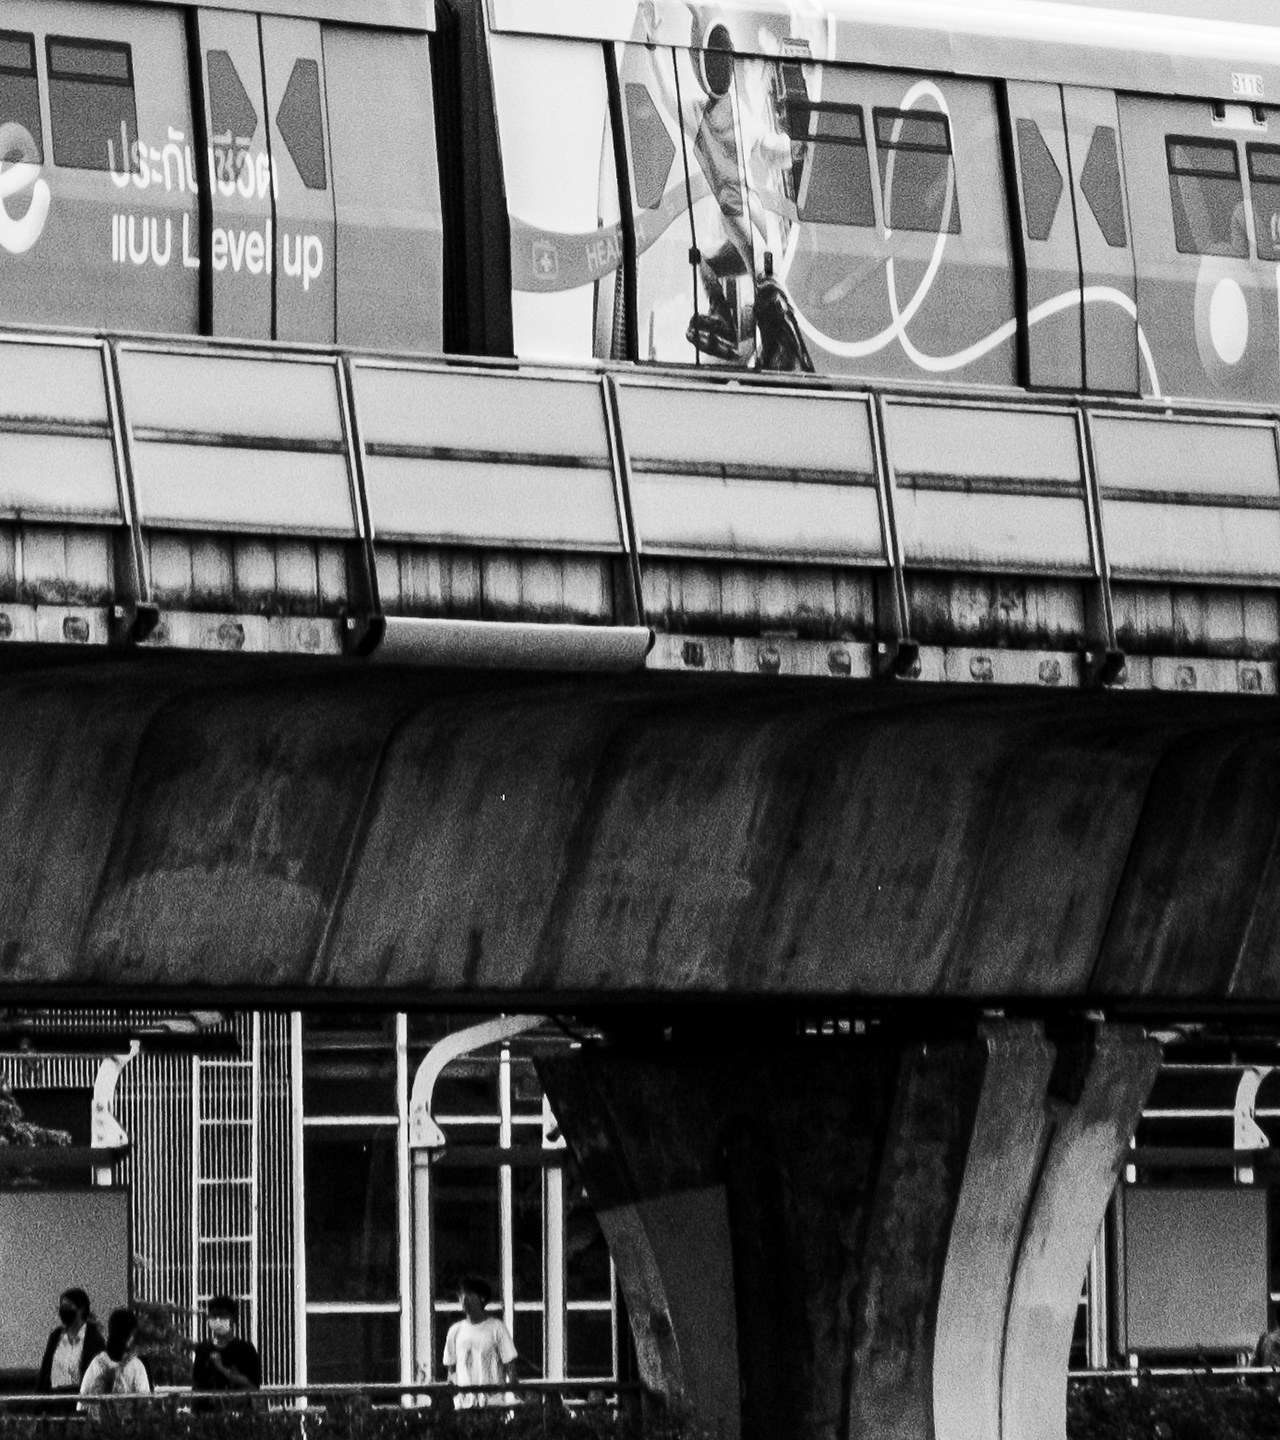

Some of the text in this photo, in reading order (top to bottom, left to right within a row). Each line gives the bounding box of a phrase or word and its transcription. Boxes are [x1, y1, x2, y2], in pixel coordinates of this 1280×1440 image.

[112, 213, 323, 291] แบบ Level up
